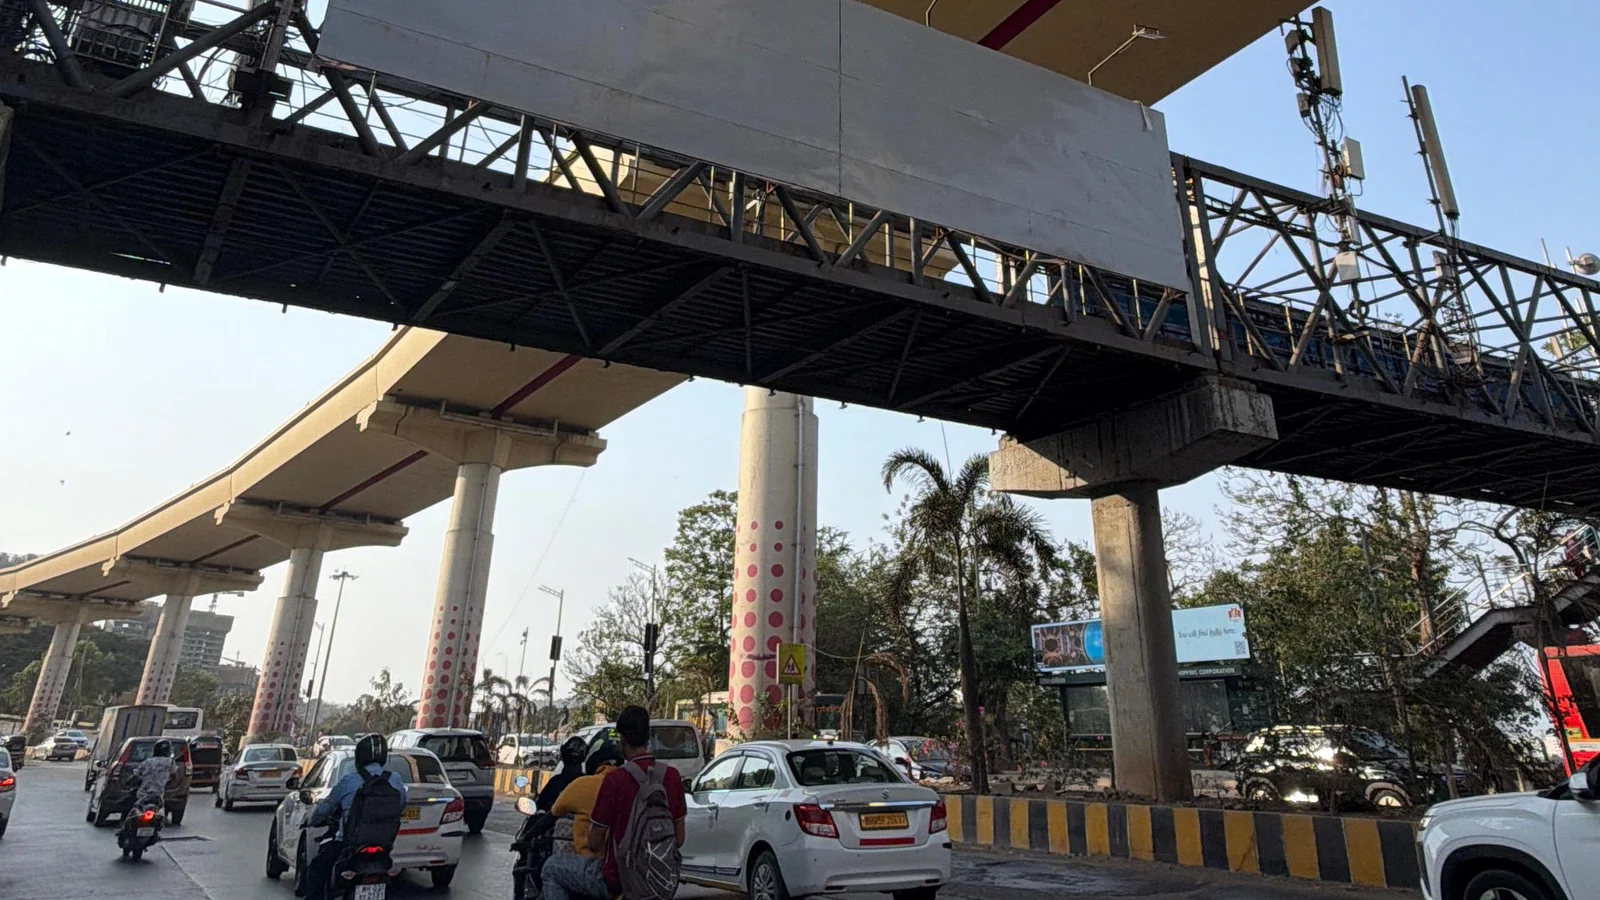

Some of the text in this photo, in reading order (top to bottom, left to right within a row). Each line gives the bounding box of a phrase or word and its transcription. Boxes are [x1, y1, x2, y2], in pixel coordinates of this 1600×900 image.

[1188, 629, 1197, 637] will
[1198, 628, 1208, 639] find
[1209, 627, 1222, 637] India
[1198, 667, 1235, 675] CORPORATION
